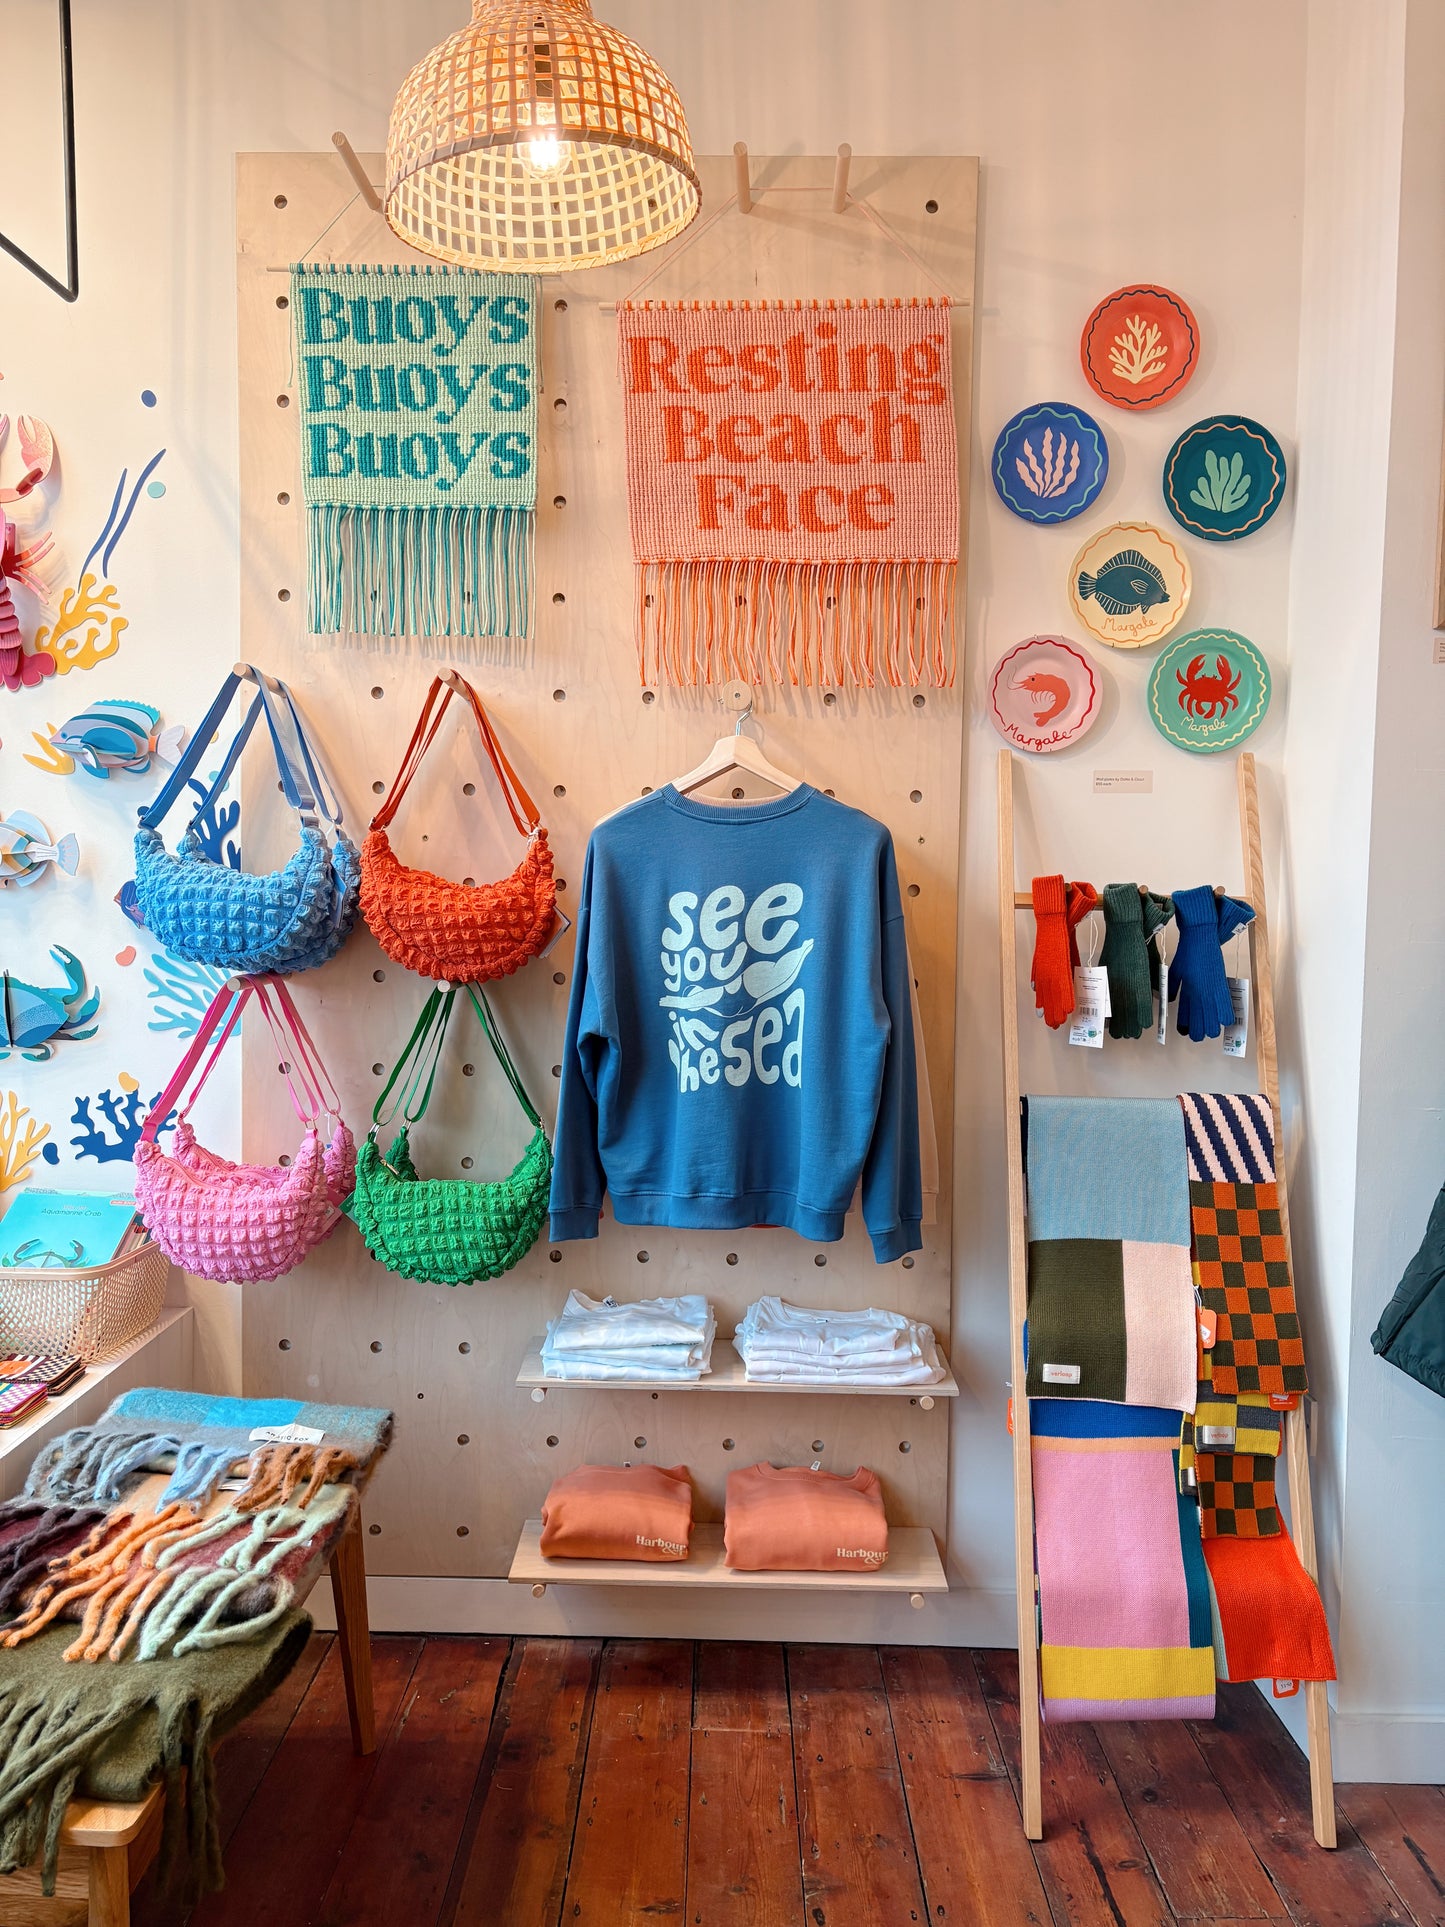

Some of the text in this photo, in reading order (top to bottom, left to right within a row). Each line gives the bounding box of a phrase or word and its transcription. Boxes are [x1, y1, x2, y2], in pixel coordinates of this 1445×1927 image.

[298, 287, 530, 357] Buoys
[303, 355, 531, 424] Buoys
[626, 321, 946, 406] Resting
[306, 422, 531, 491] Buoys
[661, 396, 926, 465] Beach
[693, 474, 895, 533] Face
[1101, 616, 1158, 637] Margate
[1003, 723, 1071, 751] Margate
[1181, 716, 1229, 737] Margate
[661, 882, 805, 955] see
[660, 941, 748, 992] you
[668, 1010, 720, 1051] in
[720, 988, 806, 1089] sea
[41, 1207, 83, 1218] Aquamarine
[84, 1209, 102, 1218] Crab
[635, 1534, 687, 1552] Harbour
[836, 1547, 889, 1561] Harbour
